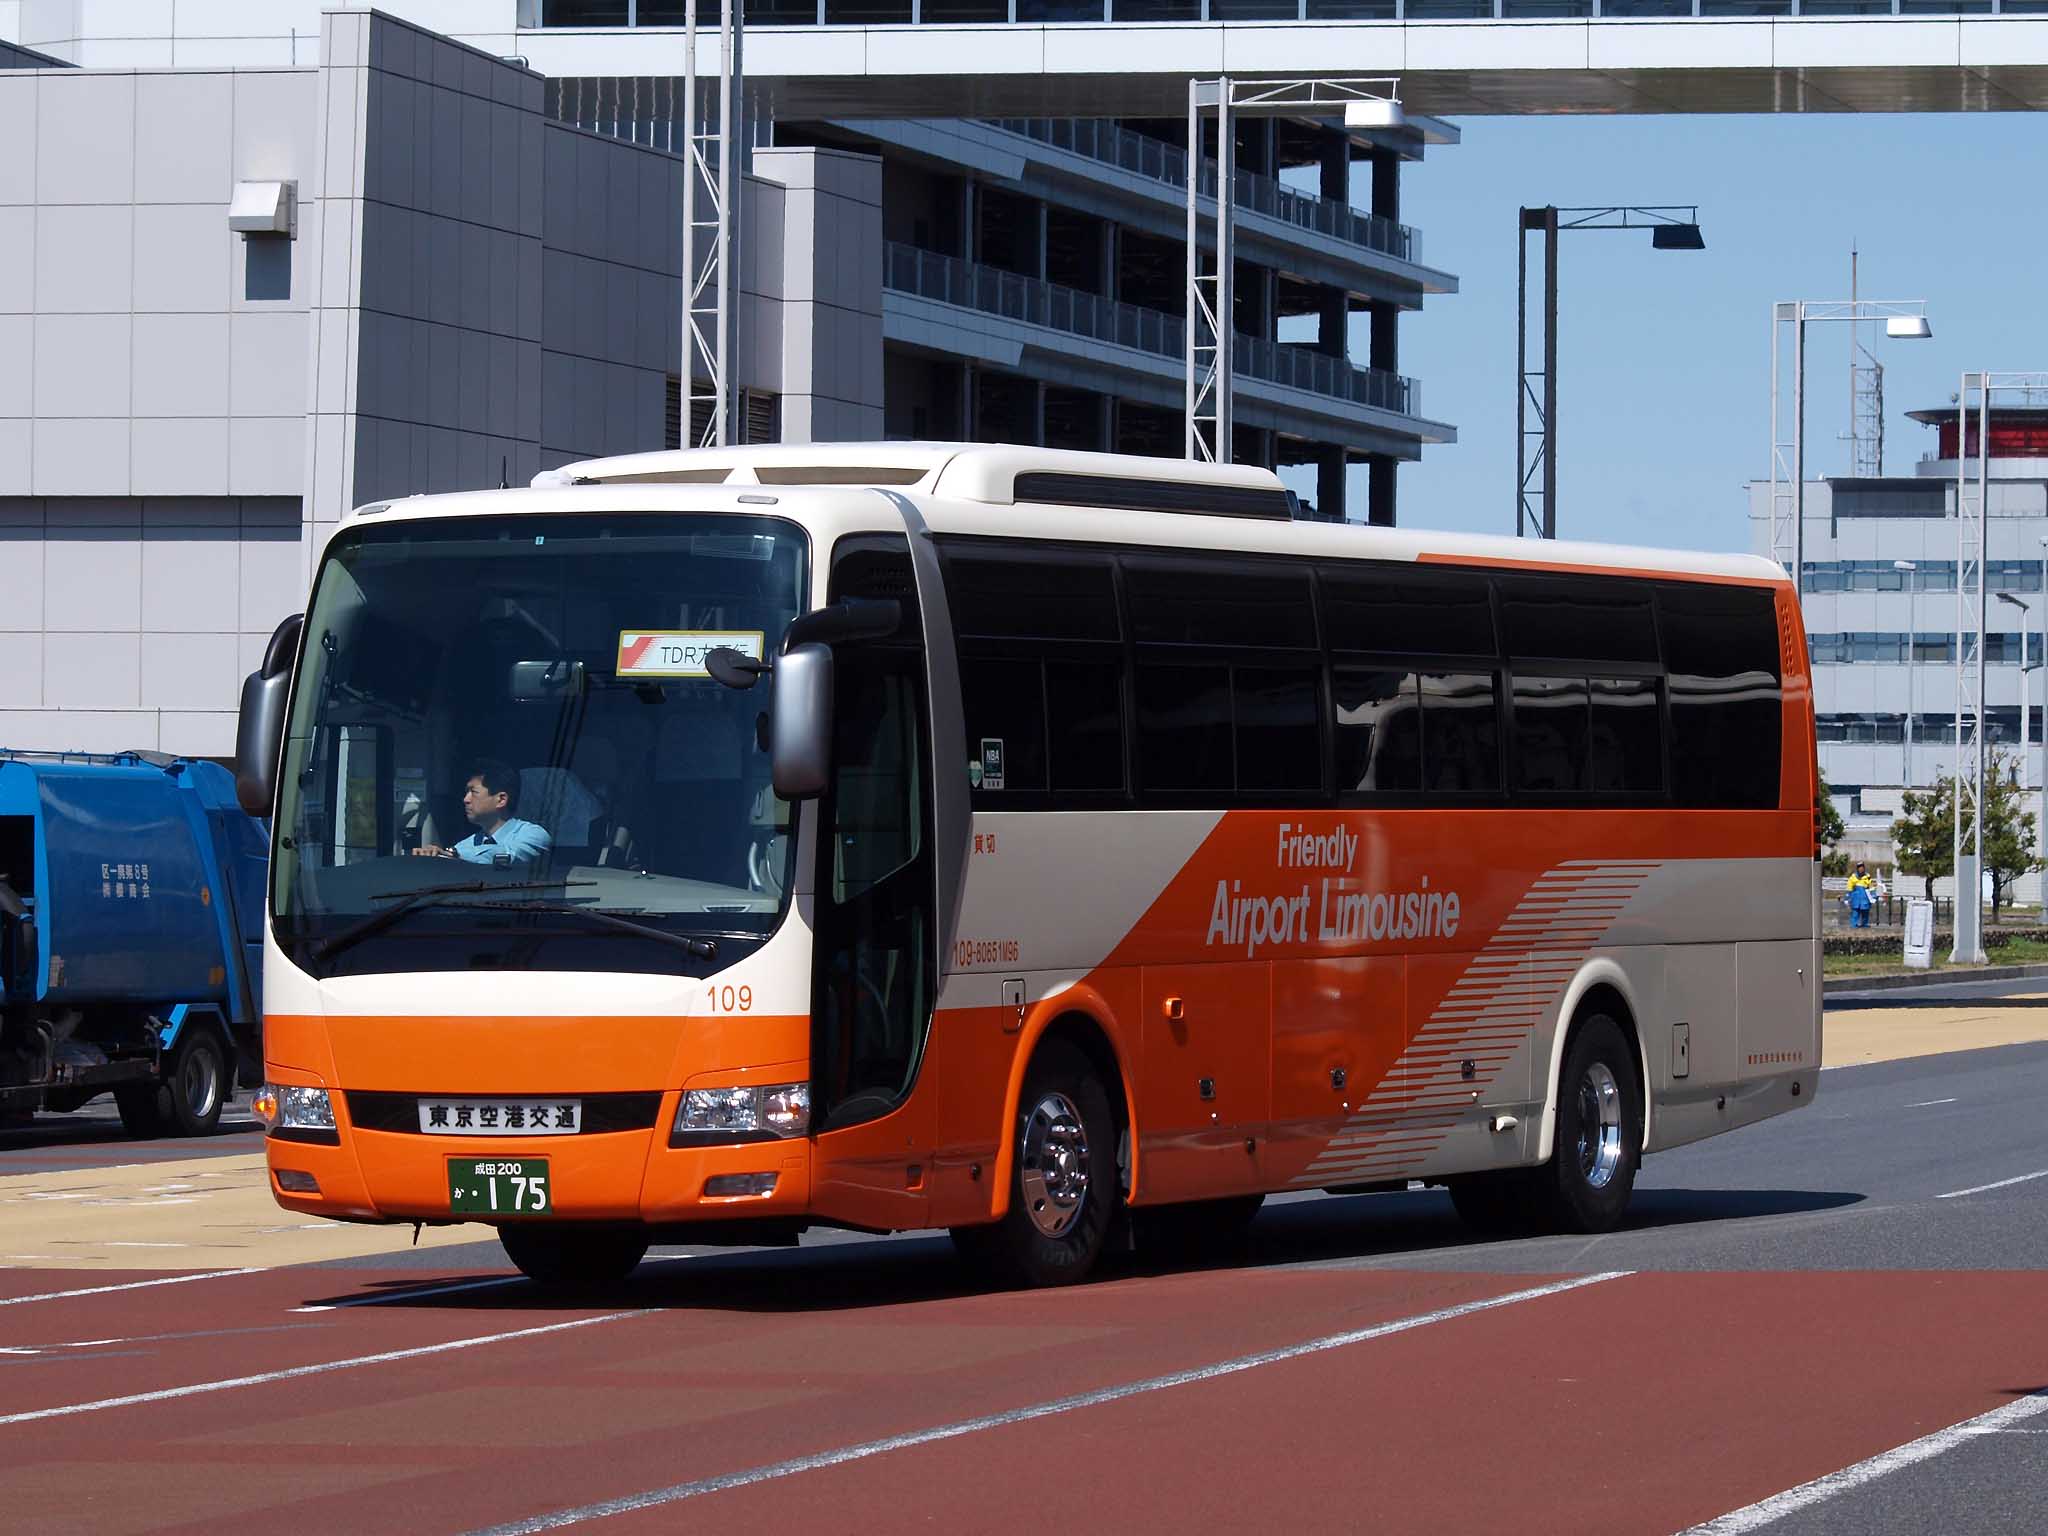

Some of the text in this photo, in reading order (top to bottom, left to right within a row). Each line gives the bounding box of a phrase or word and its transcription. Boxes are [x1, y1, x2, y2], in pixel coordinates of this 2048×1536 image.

[1277, 823, 1358, 872] Friendly
[1206, 875, 1460, 958] Airport Limousine
[707, 985, 752, 1012] 109
[428, 1104, 576, 1128] 東京空港交通
